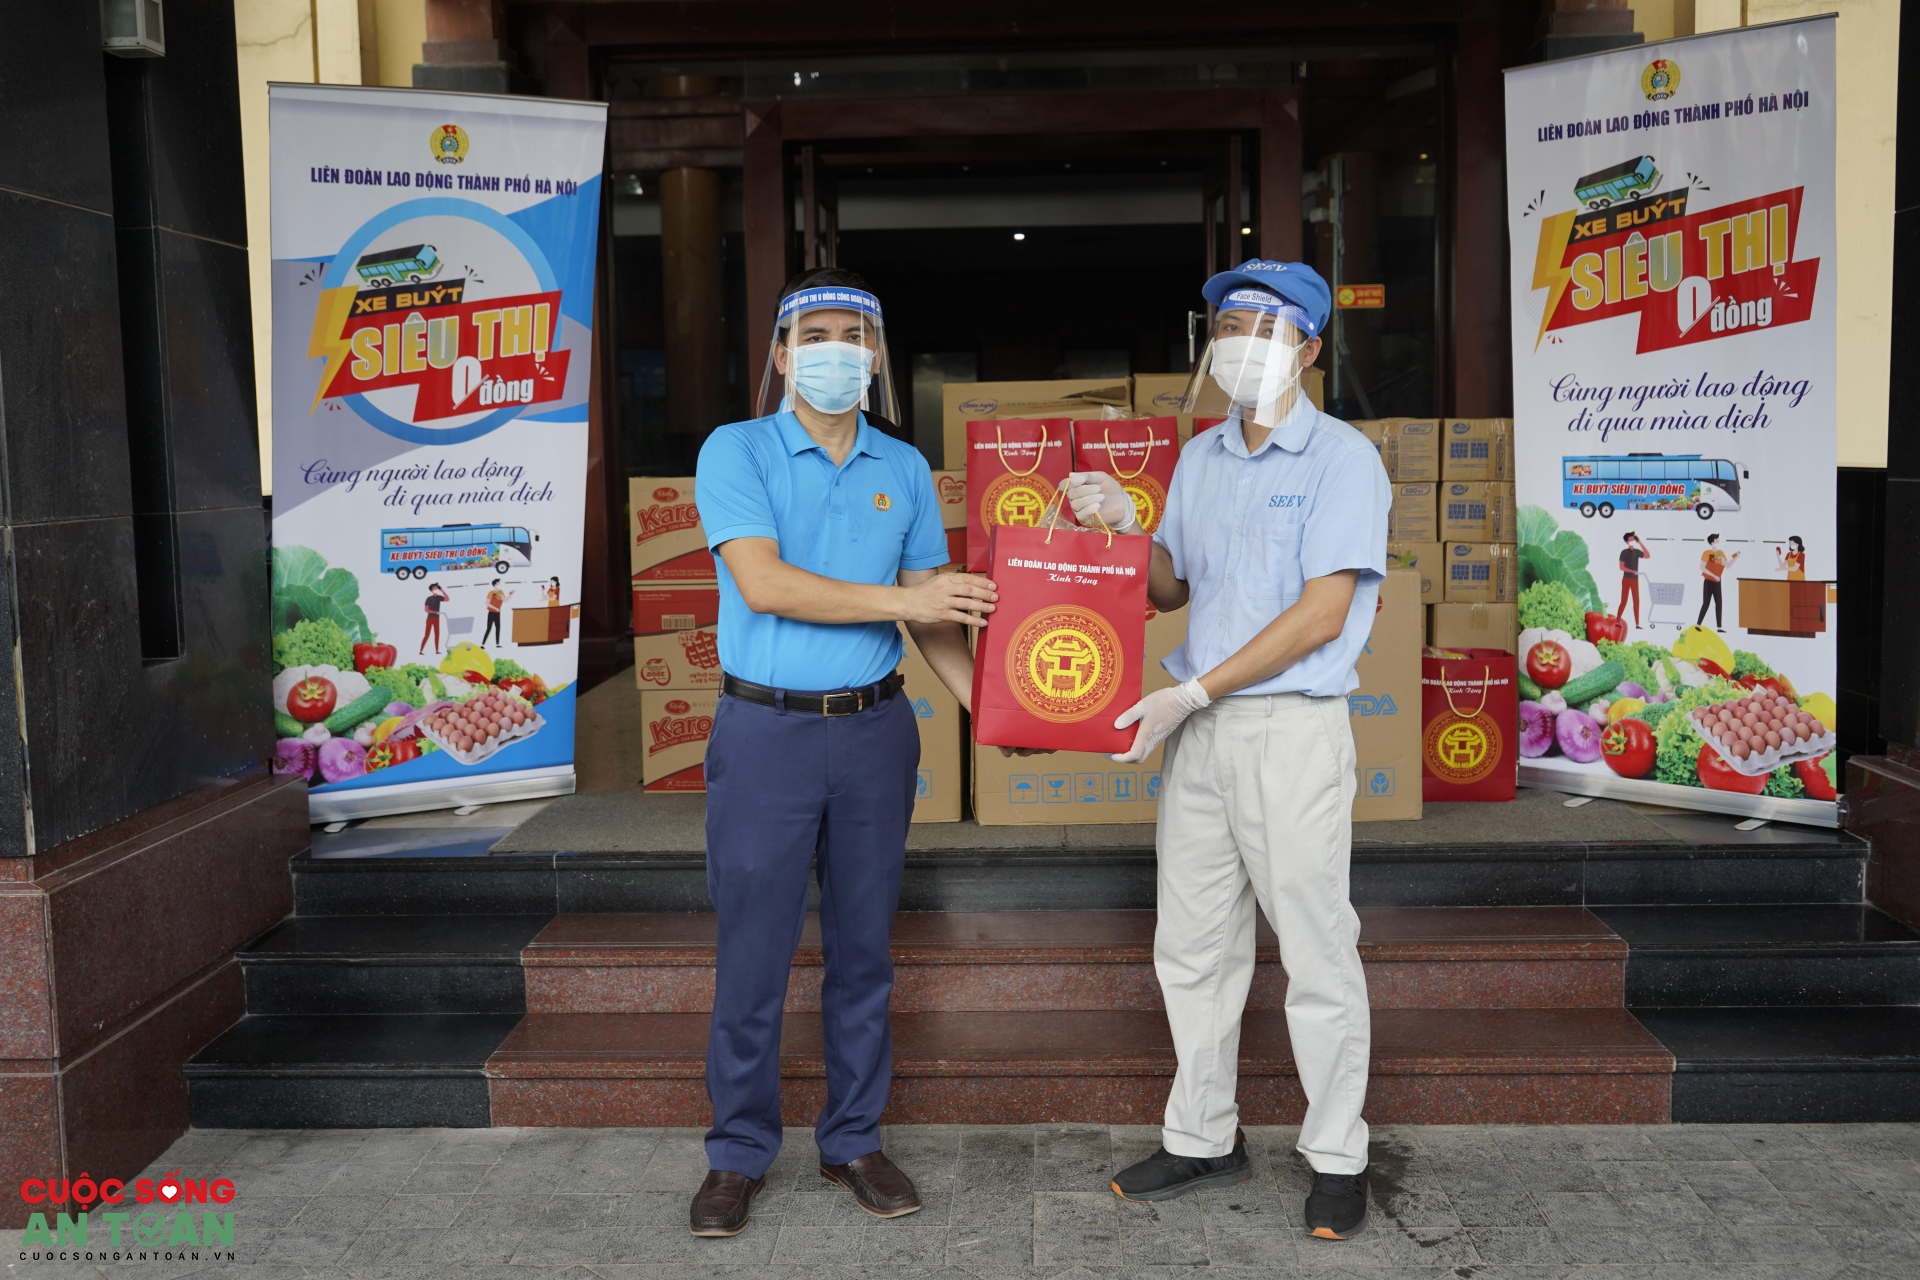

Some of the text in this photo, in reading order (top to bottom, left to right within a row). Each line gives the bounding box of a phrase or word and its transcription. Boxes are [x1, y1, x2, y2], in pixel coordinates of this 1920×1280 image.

[1538, 89, 1809, 142] LIÊN ĐOÀN LAO ĐỘNG THÀNH PHỐ HÀ NỘI
[311, 166, 578, 198] LIÊN ĐOÀN LAO ĐỘNG THÀNH PHỐ HÀ NỘI
[1574, 198, 1686, 239] XE BUÝT
[1242, 262, 1288, 272] SEEV
[1572, 204, 1788, 311] SIÊU THỊ
[355, 285, 463, 314] XE BUÝT
[837, 292, 850, 300] CÔNG
[1252, 293, 1272, 304] Shield
[1710, 295, 1772, 333] đồng
[350, 302, 550, 380] SIÊU THỊ
[479, 375, 534, 406] đồng
[1550, 370, 1812, 412] Cùng người lao động
[1568, 403, 1771, 442] đi qua mùa dịch
[300, 458, 525, 492] Cùng người lao động
[1573, 484, 1584, 494] XE
[1586, 482, 1608, 494] BUÝT
[1611, 482, 1630, 494] SIÊU
[1633, 484, 1648, 496] THỊ
[1659, 480, 1685, 495] ĐỒNG
[384, 482, 554, 515] đi qua mùa dịch
[1268, 495, 1306, 508] SEEV
[637, 504, 700, 532] Karo
[390, 552, 400, 561] XE
[402, 550, 424, 560] BUÝT
[425, 548, 442, 559] SIÊU
[446, 550, 458, 560] THỊ
[467, 545, 488, 556] ĐỒNG
[1008, 558, 1136, 577] LIÊN ĐOÀN LAO ĐỘNG THÀNH PHỐ HÀ NỘI
[650, 716, 714, 744] Karo
